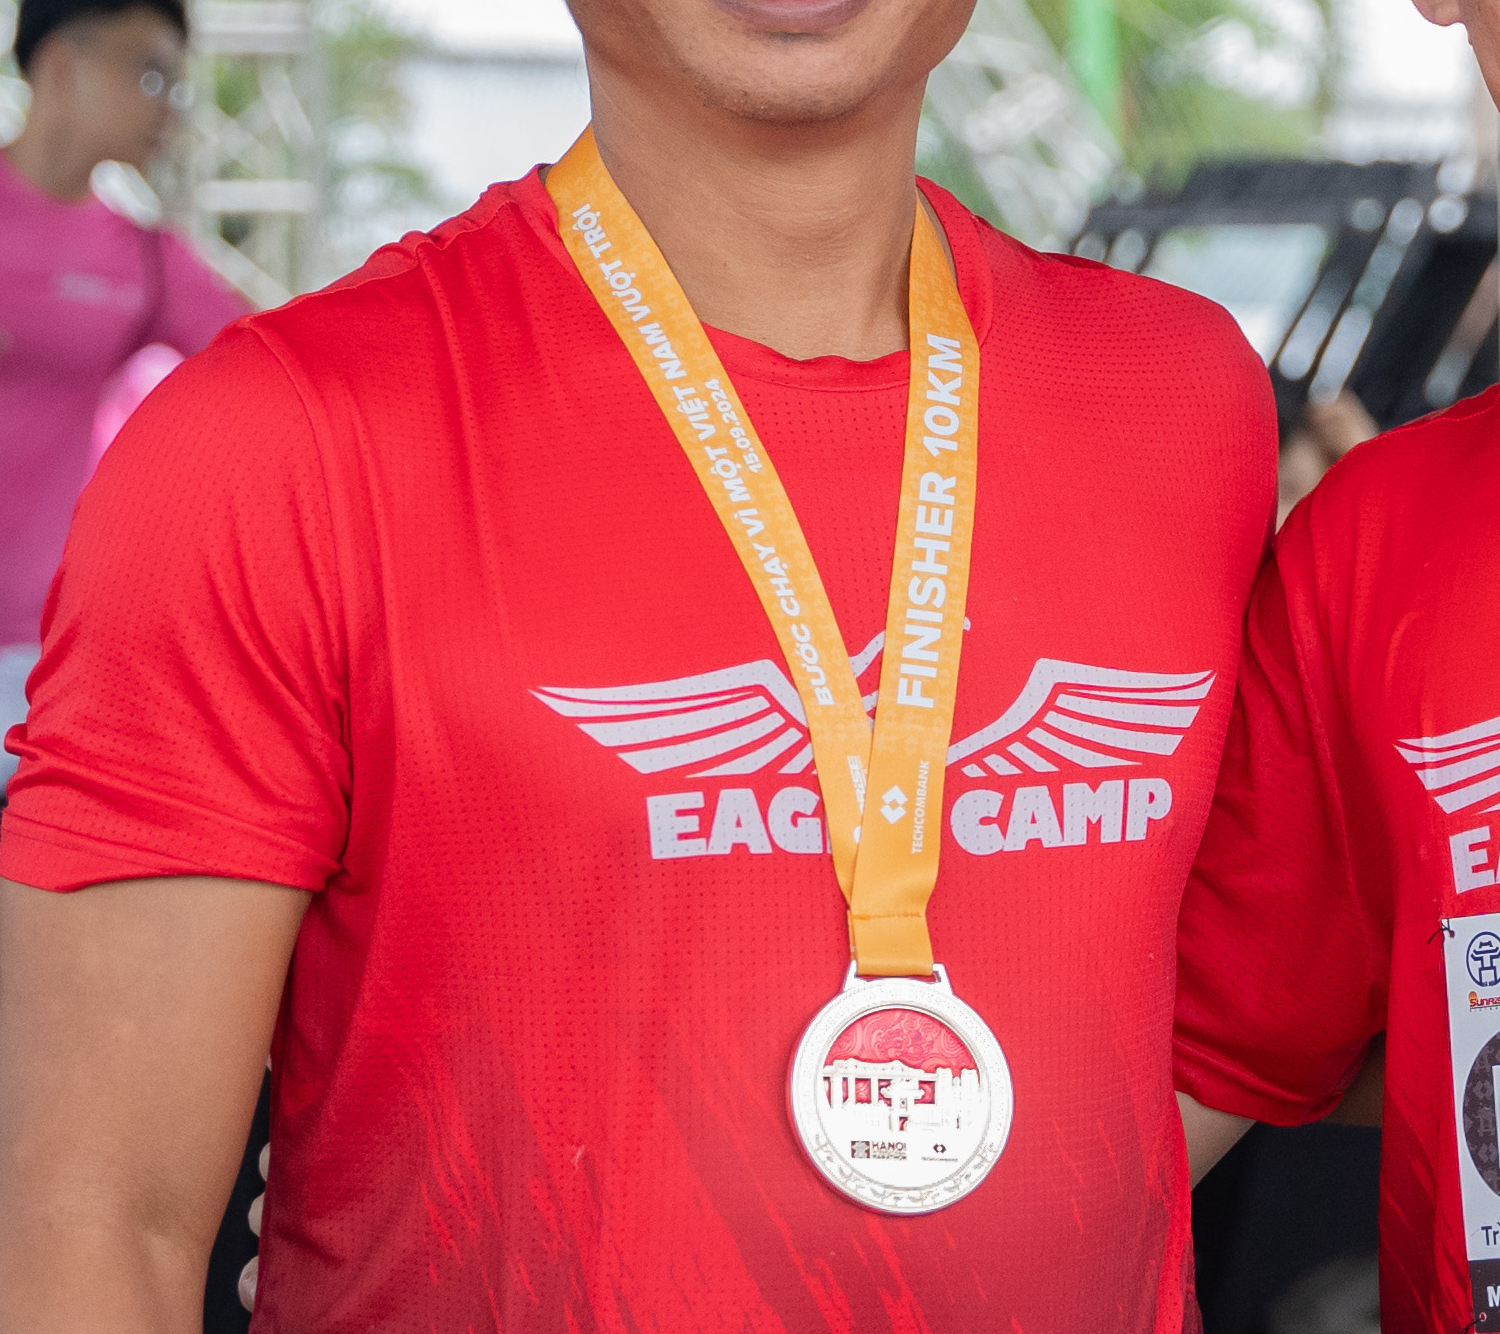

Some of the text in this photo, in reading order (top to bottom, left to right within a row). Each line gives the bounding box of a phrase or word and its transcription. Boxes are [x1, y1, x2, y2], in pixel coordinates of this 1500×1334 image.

[572, 203, 836, 706] BƯỚC CHẠY VÌ MỘT VIỆT NAM VƯỢT TRỘI
[704, 377, 763, 474] 15.09.2024
[896, 333, 964, 709] FINISHER 10KM
[646, 777, 1173, 860] EAG CAMP
[910, 759, 931, 855] TECHCOMBANK
